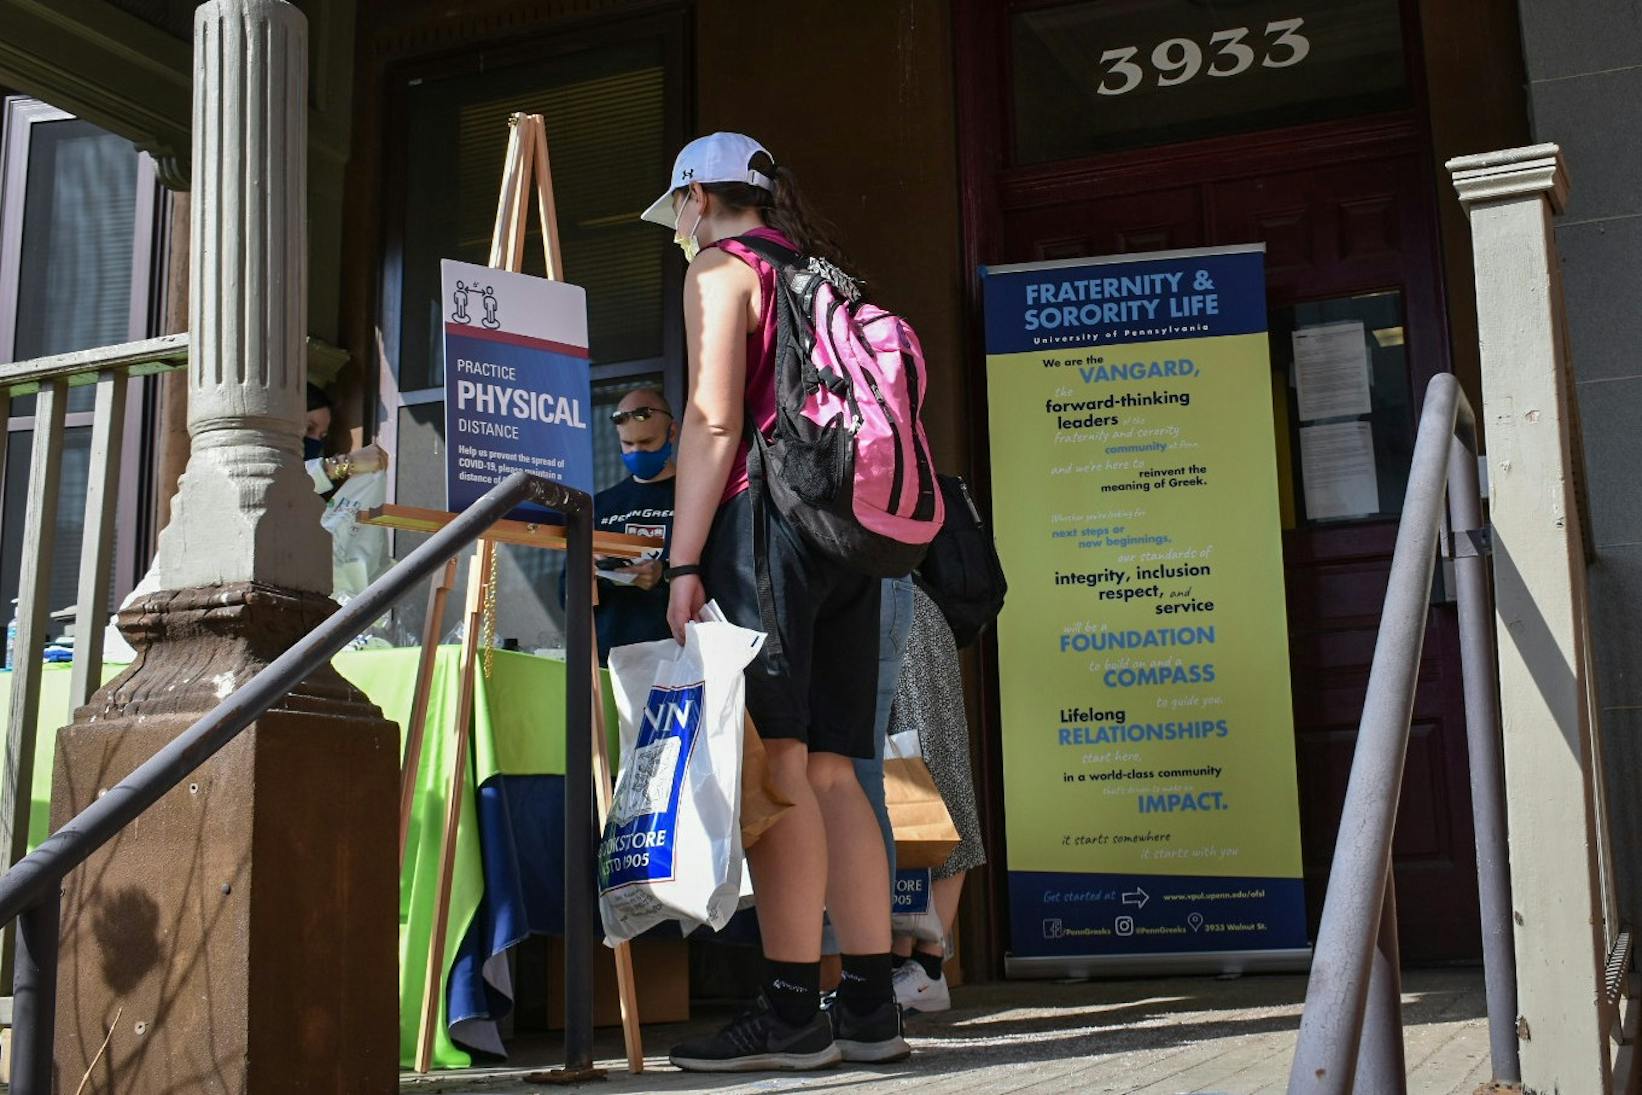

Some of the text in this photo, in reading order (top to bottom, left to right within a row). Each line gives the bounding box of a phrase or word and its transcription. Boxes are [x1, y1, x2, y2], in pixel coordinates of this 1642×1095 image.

[1097, 17, 1311, 96] 3933
[1025, 270, 1215, 305] FRATERNITY &
[1024, 294, 1219, 331] SORORITY LIFE
[1033, 323, 1209, 345] University of Pennsylvania
[457, 359, 516, 381] PRACTICE
[1042, 355, 1104, 368] We are the
[1079, 358, 1200, 384] VANGARD,
[457, 379, 587, 430] PHYSICAL
[1045, 390, 1190, 414] forward-thinking
[458, 418, 519, 440] DISTANCE
[1057, 414, 1119, 430] leaders
[458, 445, 565, 469] Help us prevent the spread of
[1105, 441, 1168, 455] community
[458, 458, 497, 472] COVID-19,
[1139, 464, 1207, 478] reinvent the
[459, 472, 492, 484] distance
[1101, 475, 1207, 493] meaning of Greek.
[1052, 525, 1125, 539] next steps or
[1078, 534, 1172, 549] new beginnings.
[1055, 563, 1211, 587] integrity, inclusion
[1099, 585, 1192, 602] respect, and
[1155, 598, 1214, 615] service
[1060, 625, 1216, 652] FOUNDATION
[1104, 664, 1216, 687] COMPASS
[1061, 707, 1126, 724] Lifelong
[1058, 720, 1228, 745] RELATIONSHIPS
[1064, 772, 1074, 782] in
[1089, 769, 1154, 781] world-class
[1158, 765, 1222, 778] community
[1138, 792, 1228, 813] IMPACT.
[1112, 831, 1171, 844] somewhere
[1227, 922, 1255, 932] Walnut
